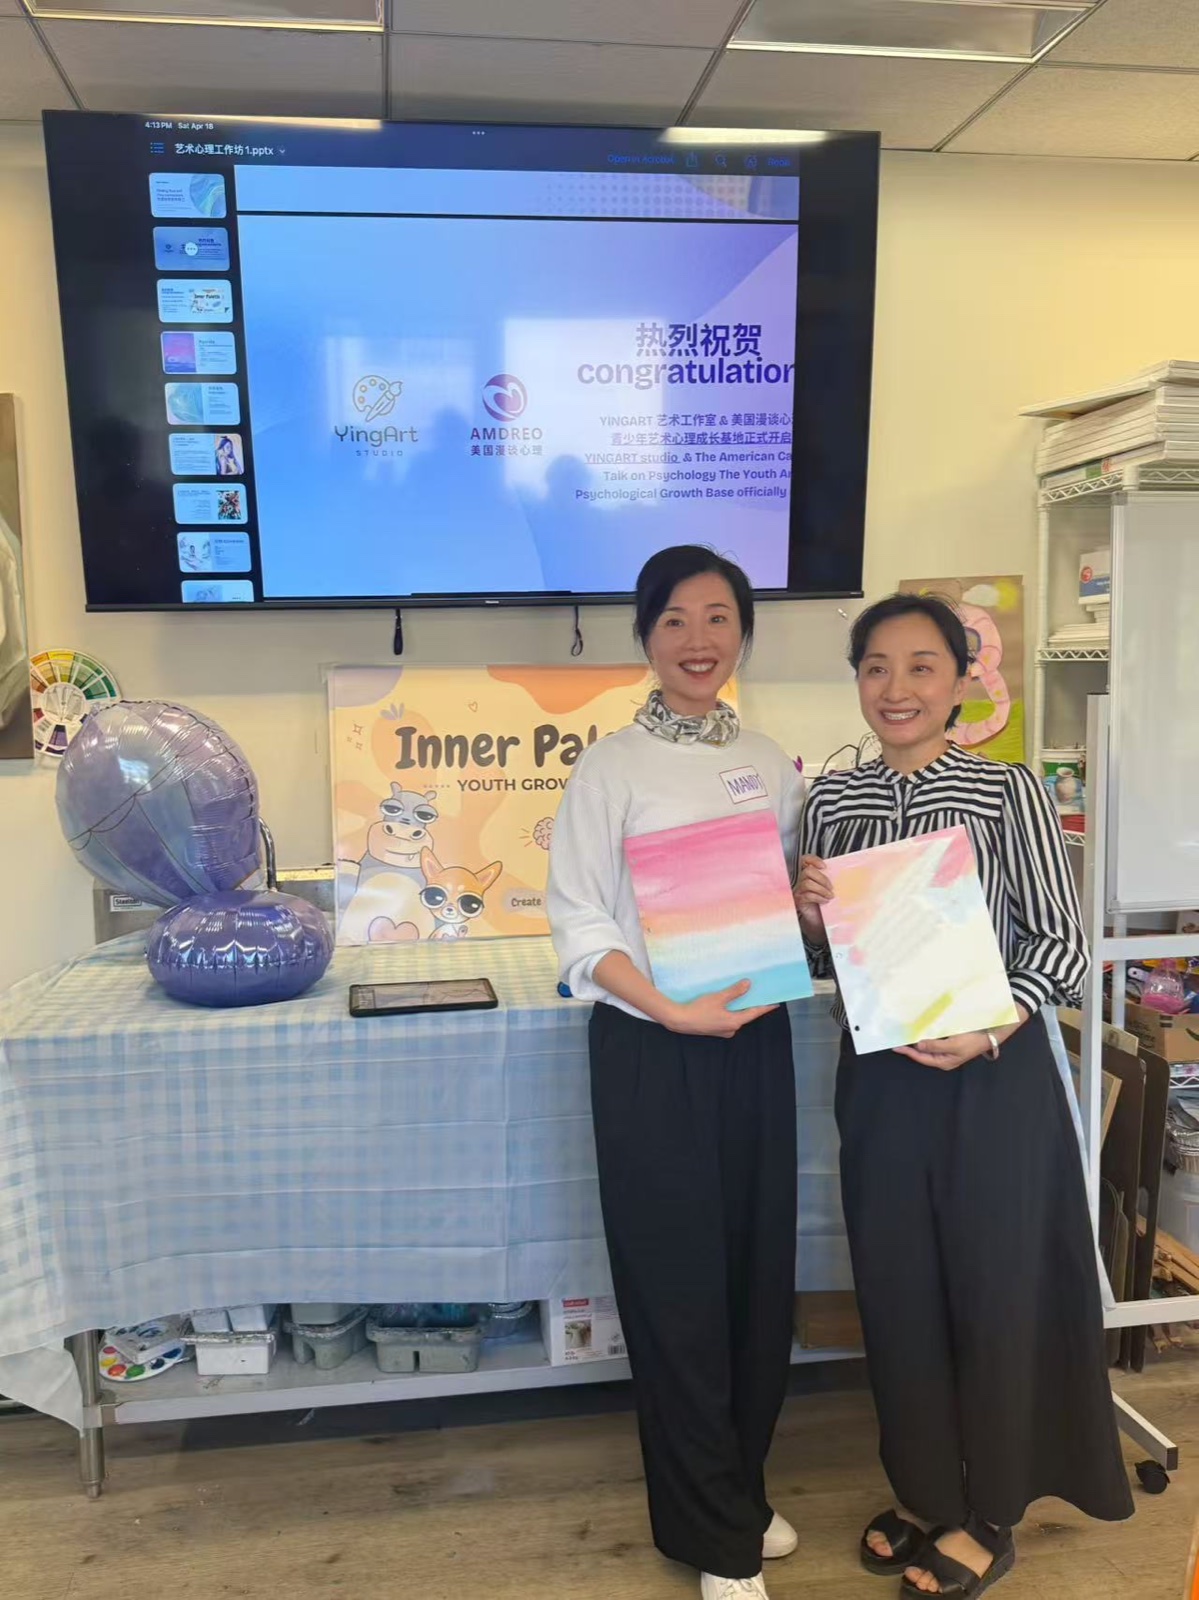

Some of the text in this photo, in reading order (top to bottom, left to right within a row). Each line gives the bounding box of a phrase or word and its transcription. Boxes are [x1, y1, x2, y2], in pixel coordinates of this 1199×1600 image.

[178, 122, 189, 130] Sat
[191, 123, 203, 131] Apr
[174, 143, 243, 155] 艺术心理工作坊
[635, 322, 763, 357] 热烈祝贺
[600, 412, 793, 427] YINGART 艺术工作室 & 美国漫谈心
[334, 425, 419, 447] YingArt
[470, 427, 543, 441] AMDREO
[355, 449, 404, 457] STUDIO
[470, 444, 543, 456] 美国漫谈心理
[585, 453, 638, 463] YINGART
[640, 452, 679, 463] studio
[682, 452, 693, 462] &
[695, 451, 717, 462] The
[719, 450, 775, 462] American
[603, 469, 628, 481] Talk
[630, 471, 646, 481] on
[648, 469, 716, 483] Psychology
[719, 469, 741, 480] The
[743, 468, 777, 480] Youth
[575, 486, 787, 501] Psychological Growth Base officially
[394, 724, 616, 770] Inner Pal
[457, 779, 517, 792] YOUTH
[511, 897, 542, 907] Create
